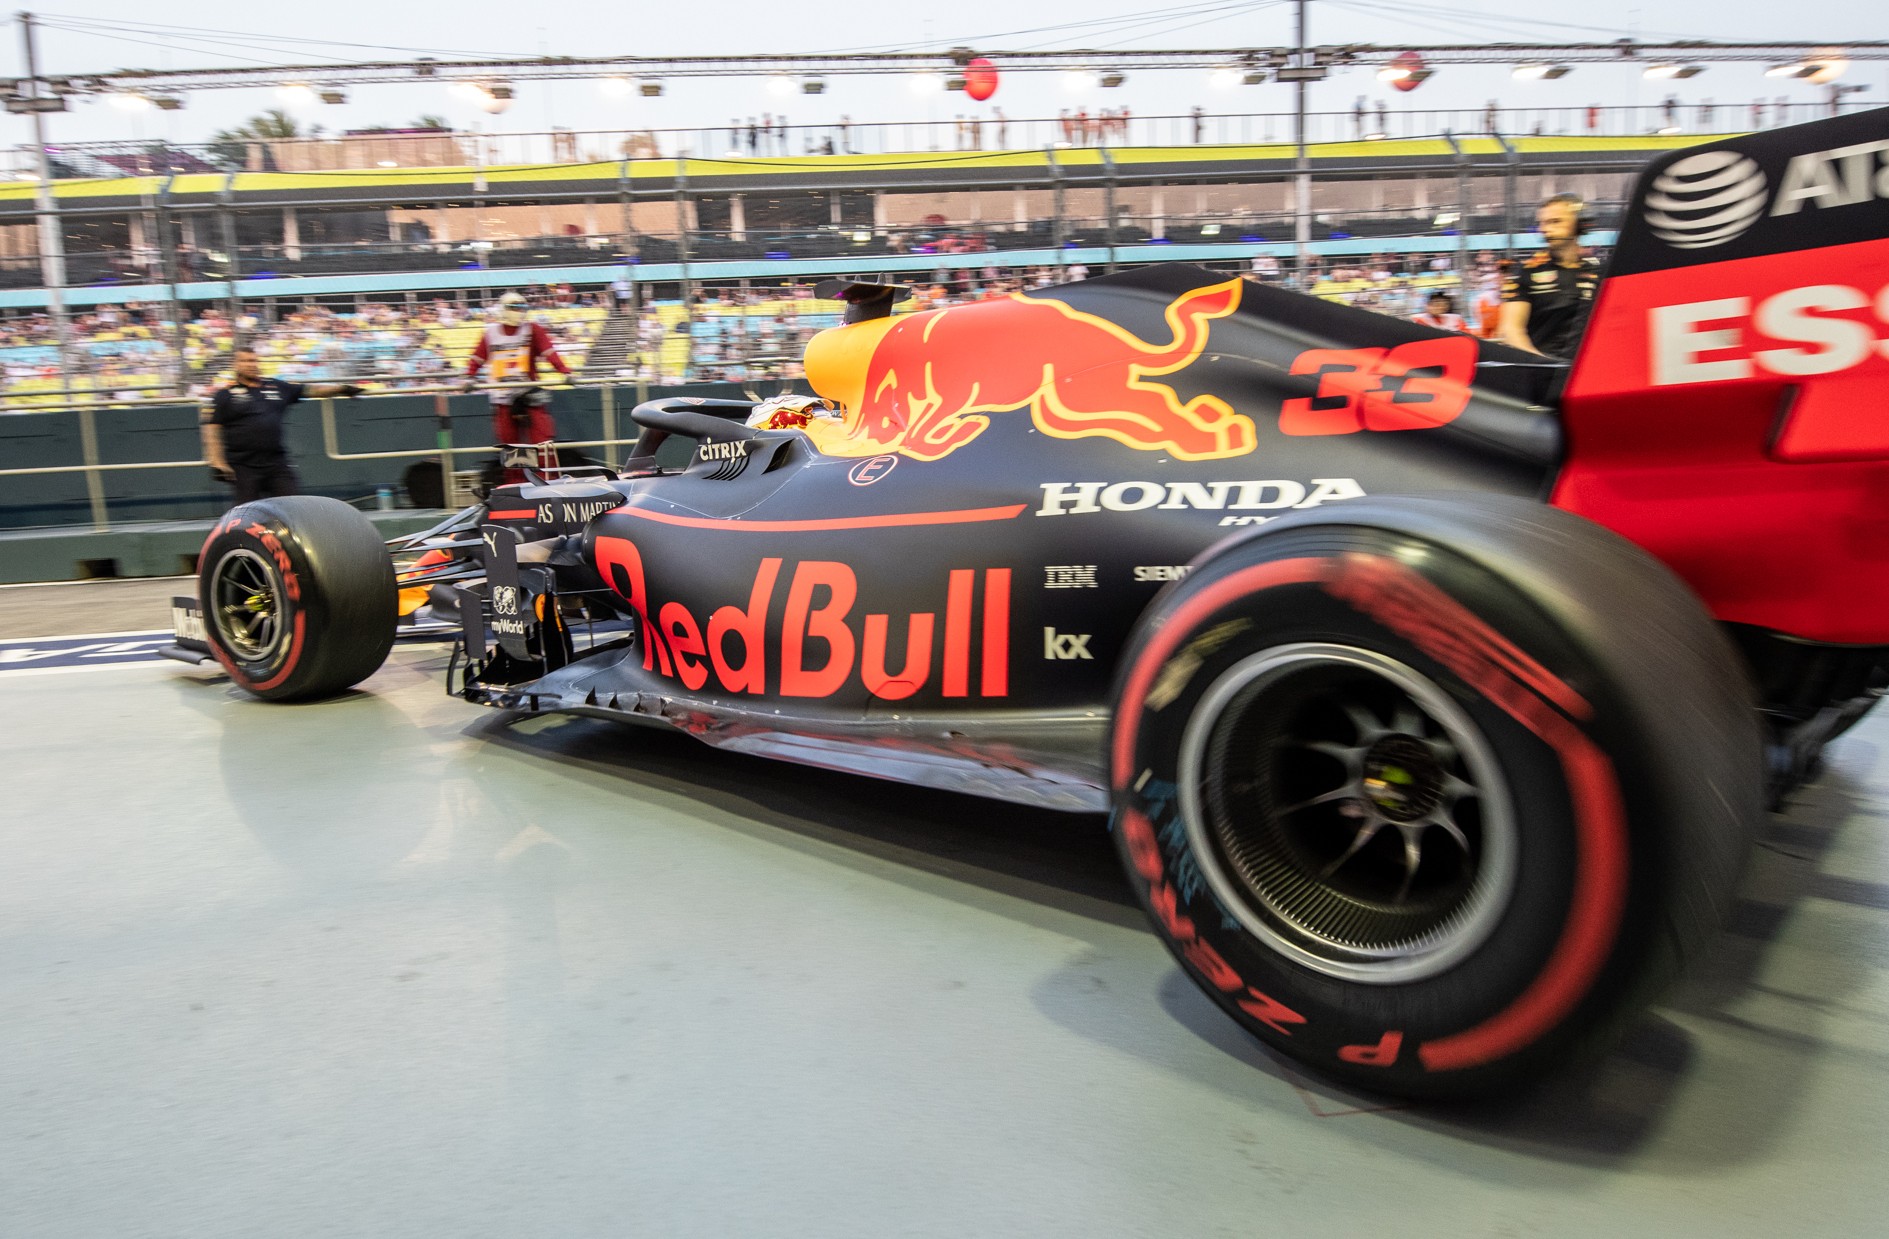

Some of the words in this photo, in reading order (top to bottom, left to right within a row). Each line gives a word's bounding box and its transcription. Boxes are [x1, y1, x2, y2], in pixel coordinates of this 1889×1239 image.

[1648, 285, 1889, 387] ES
[1278, 335, 1480, 436] 33
[1036, 478, 1367, 517] HONDA
[537, 503, 577, 524] ASN
[1217, 515, 1280, 526] HY
[1043, 565, 1099, 588] IBM
[1133, 565, 1194, 581] SIEM
[1043, 626, 1094, 660] kx
